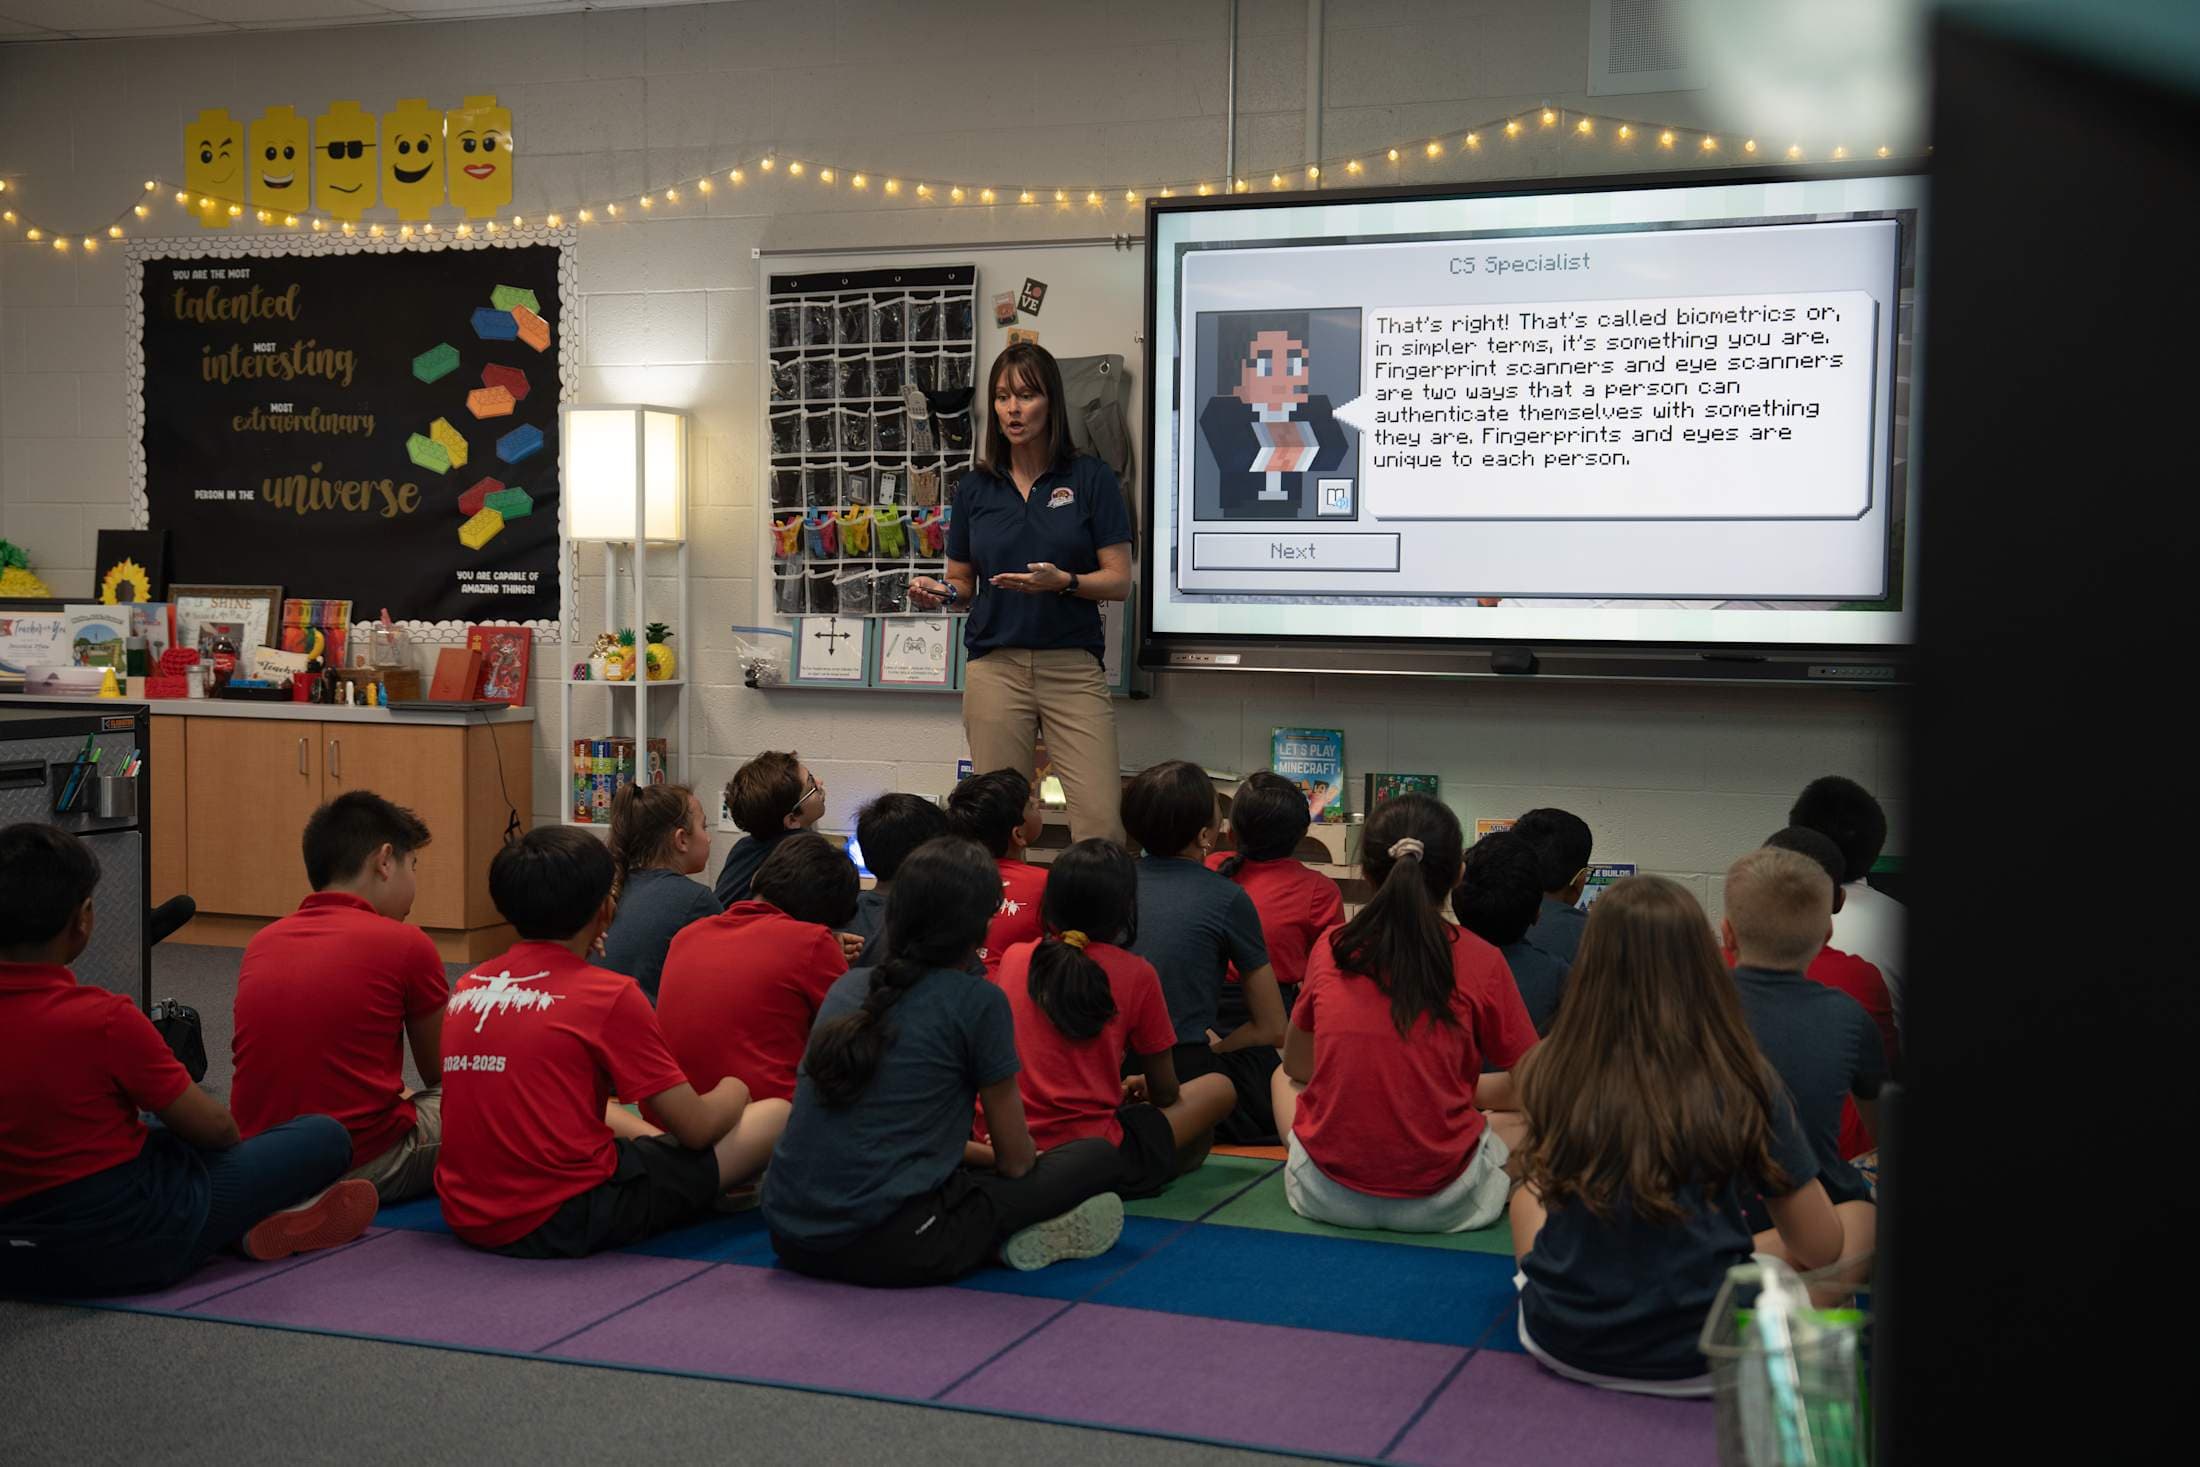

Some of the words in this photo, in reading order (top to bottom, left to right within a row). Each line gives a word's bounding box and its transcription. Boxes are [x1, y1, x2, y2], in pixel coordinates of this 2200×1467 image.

[172, 269, 190, 280] YOU
[192, 269, 208, 280] ARE
[210, 268, 226, 279] THE
[227, 268, 251, 279] MOST
[1449, 256, 1476, 275] CS
[1484, 252, 1590, 276] Specialist
[172, 283, 301, 324] talented
[1376, 315, 1443, 334] That's
[1452, 313, 1509, 334] right!
[1519, 311, 1588, 330] That's
[1597, 308, 1667, 328] called
[1676, 304, 1796, 326] biometrics
[1807, 307, 1840, 322] or,
[253, 342, 276, 352] MOST
[1375, 339, 1392, 357] in
[1401, 338, 1477, 358] simpler
[1487, 336, 1553, 355] terms,
[1563, 334, 1596, 352] it's
[1606, 330, 1718, 351] something
[1728, 333, 1771, 350] you
[1781, 331, 1829, 345] are.
[201, 338, 358, 387] interesting
[1375, 359, 1497, 381] Fingerprint
[1506, 361, 1614, 376] scanners
[1624, 355, 1665, 373] and
[1675, 358, 1717, 374] eye
[1727, 354, 1844, 371] scanners
[1375, 388, 1413, 401] are
[1422, 383, 1456, 400] two
[1466, 386, 1518, 401] ways
[1528, 380, 1572, 398] that
[1582, 384, 1595, 397] a
[1605, 382, 1688, 399] person
[1698, 381, 1740, 395] can
[270, 403, 293, 413] MOST
[1374, 404, 1509, 424] authenticate
[1519, 402, 1643, 421] themselves
[1653, 401, 1694, 419] with
[1704, 399, 1820, 419] something
[231, 406, 376, 437] extraordinary
[1374, 428, 1421, 448] they
[1430, 432, 1473, 445] are.
[1482, 425, 1622, 446] Fingerprints
[1631, 424, 1673, 442] and
[1682, 428, 1739, 444] eyes
[1749, 427, 1792, 441] are
[1374, 450, 1442, 470] unique
[1451, 450, 1473, 467] to
[1482, 449, 1535, 467] each
[1544, 453, 1630, 469] person.
[194, 489, 225, 500] PERSON
[226, 490, 237, 500] IN
[238, 490, 255, 501] THE
[261, 461, 423, 518] universe
[1270, 542, 1316, 560] Next
[456, 570, 474, 580] YOU
[476, 570, 492, 580] ARE
[493, 571, 527, 581] CAPABLE
[528, 571, 540, 581] OF
[461, 583, 500, 594] AMAZING
[501, 584, 536, 595] THINGS!
[211, 598, 253, 610] SHINE
[1310, 743, 1337, 758] PLAY
[1279, 761, 1337, 775] MINECRAFT
